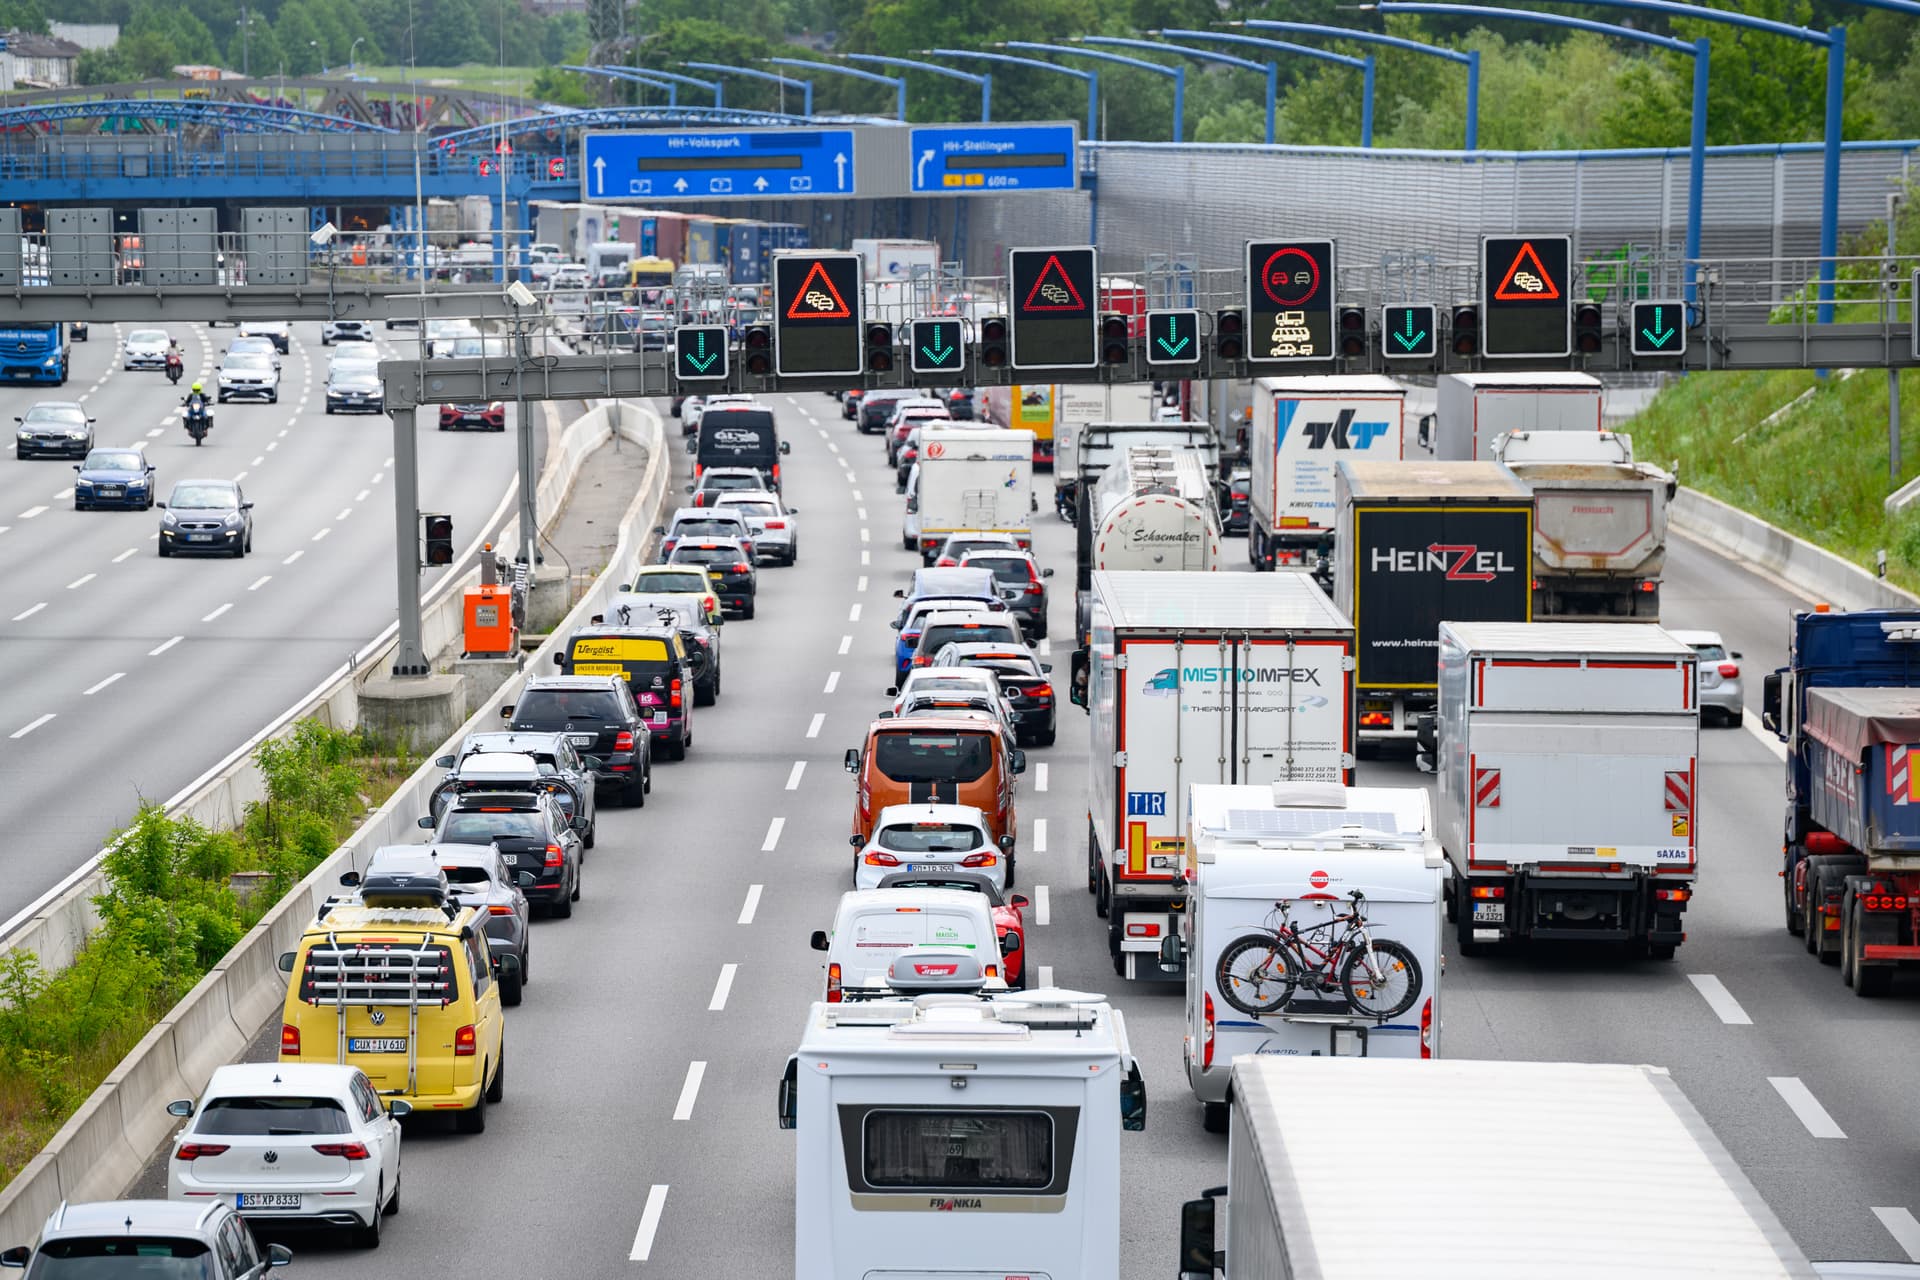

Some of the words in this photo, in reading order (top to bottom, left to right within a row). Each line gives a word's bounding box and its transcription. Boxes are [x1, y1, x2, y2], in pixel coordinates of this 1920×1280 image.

[668, 138, 741, 150] HH-Volkspark
[1131, 794, 1162, 813] TIR
[354, 1040, 371, 1050] CUX
[390, 1040, 406, 1050] 610
[243, 1194, 256, 1206] BS
[262, 1194, 275, 1206] XP
[275, 1194, 299, 1206] 8333
[929, 1198, 982, 1211] FRANKIA
